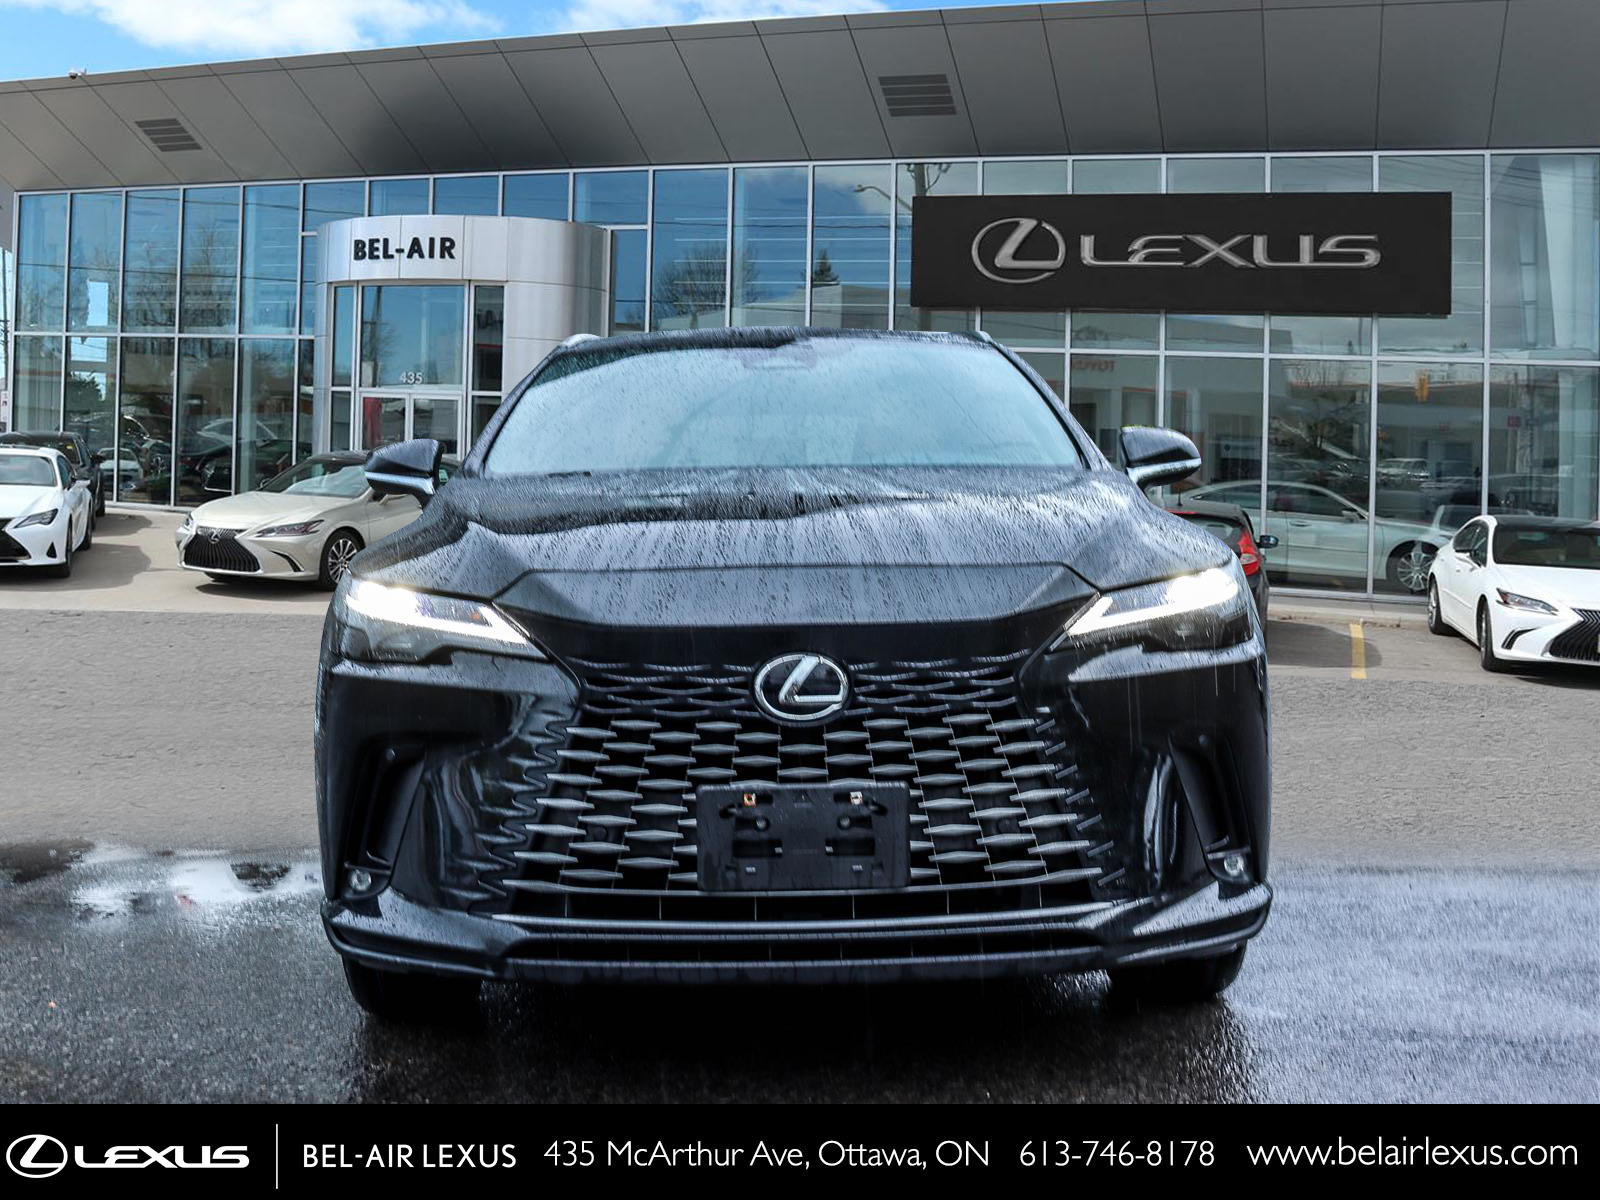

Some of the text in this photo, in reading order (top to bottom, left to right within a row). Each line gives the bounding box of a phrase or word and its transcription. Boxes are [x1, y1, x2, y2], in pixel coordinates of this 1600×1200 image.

[353, 236, 456, 261] BEL-AIR
[1080, 234, 1382, 269] LEXUS
[400, 371, 424, 385] 435
